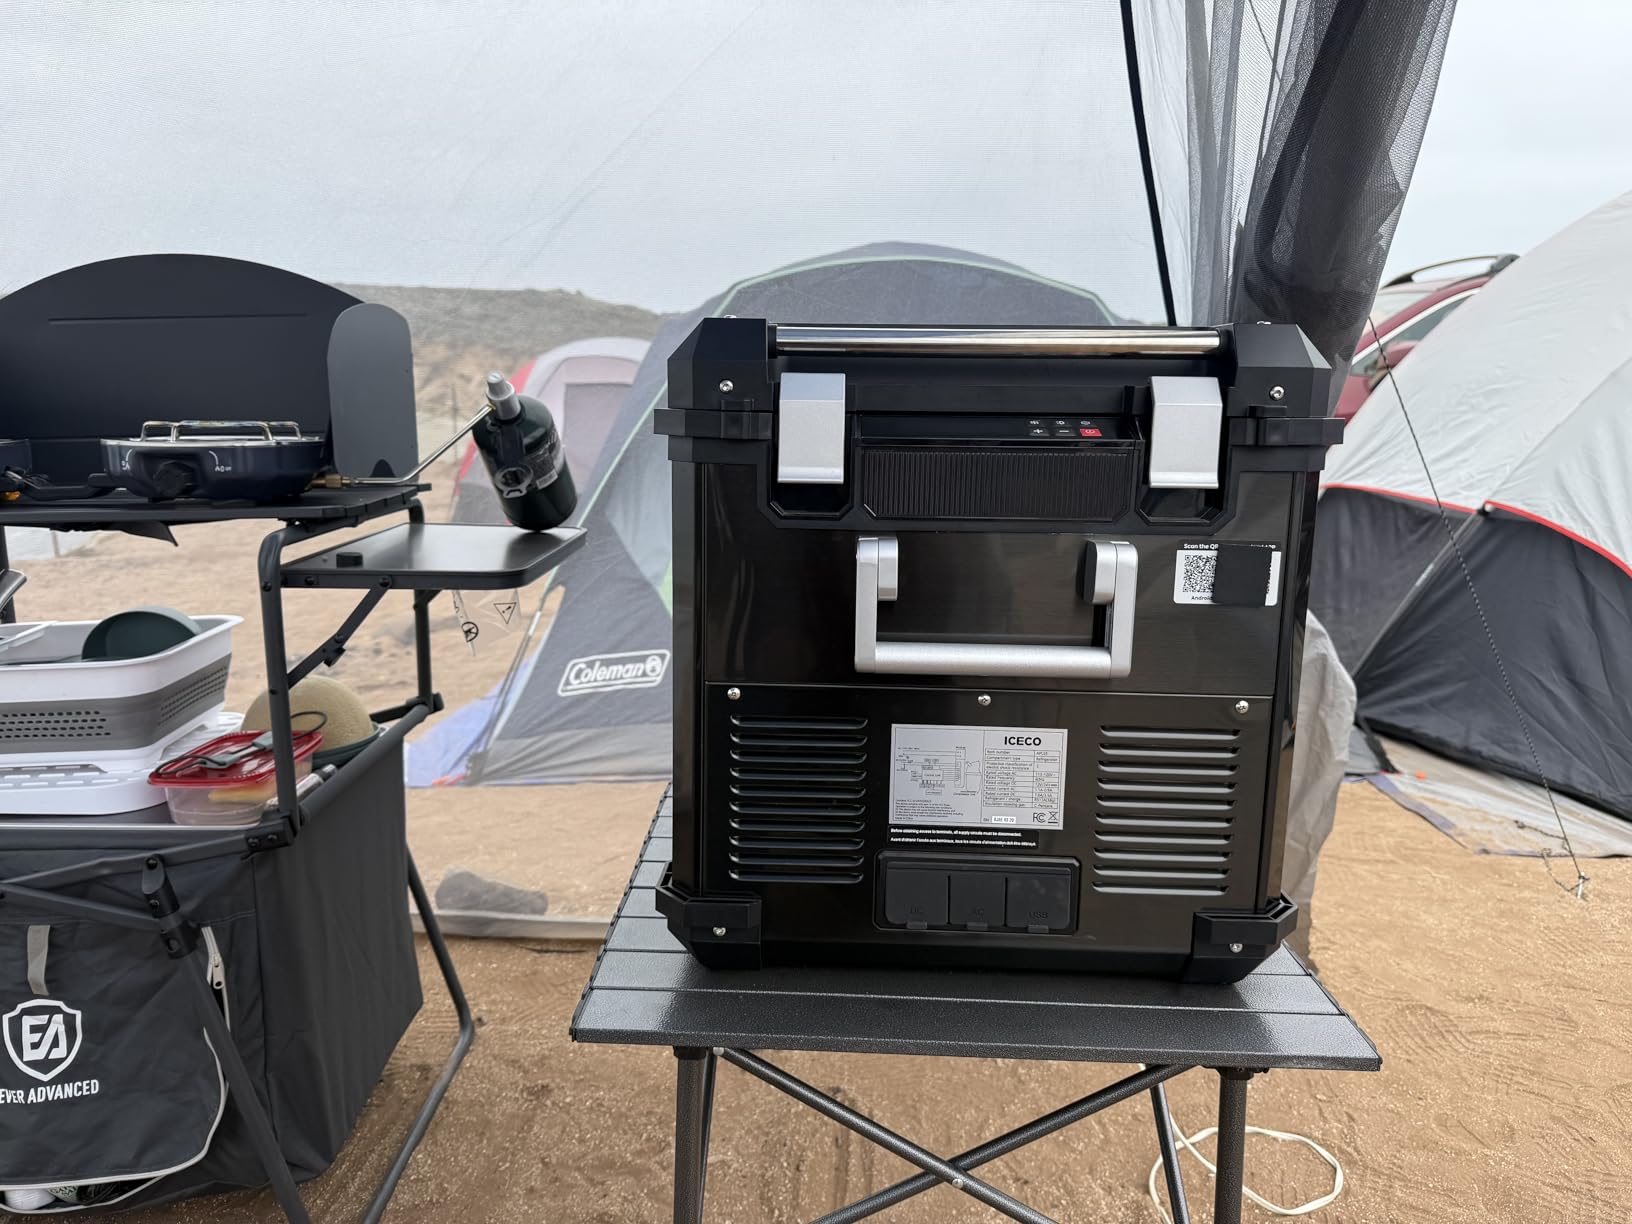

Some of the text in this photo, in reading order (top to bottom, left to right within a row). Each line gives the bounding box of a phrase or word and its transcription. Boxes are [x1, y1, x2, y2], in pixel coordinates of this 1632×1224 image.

[569, 661, 643, 684] Coleman
[1004, 736, 1042, 746] ICECO
[0, 1079, 99, 1104] EVER ADVANCED
